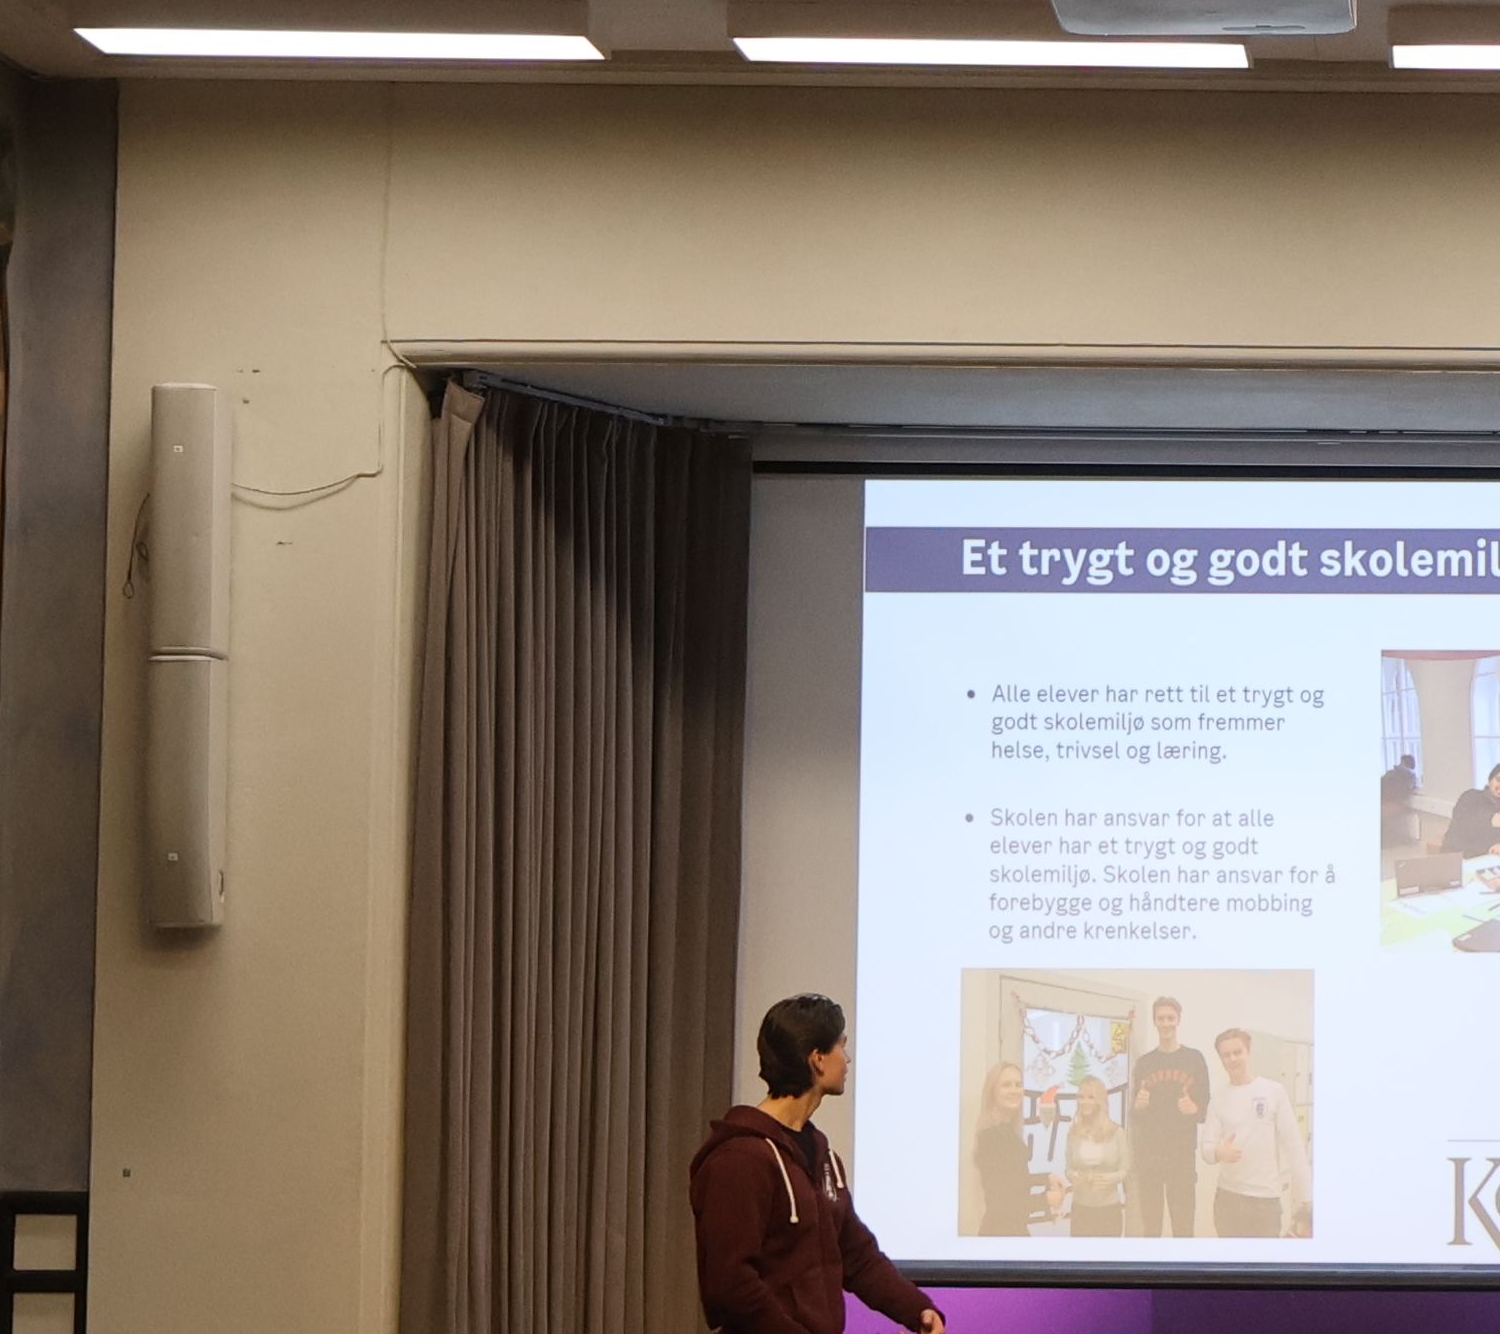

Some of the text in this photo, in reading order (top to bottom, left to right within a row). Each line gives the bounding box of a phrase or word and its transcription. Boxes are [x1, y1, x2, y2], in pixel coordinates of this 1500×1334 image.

[962, 538, 1008, 576] Et
[1018, 540, 1135, 586] trygt
[1146, 548, 1199, 586] og
[1207, 540, 1309, 586] godt
[991, 684, 1325, 709] Alle elever har rett til et trygt og
[991, 711, 1286, 736] godt skolemiljø som fremmer
[991, 740, 1227, 765] helse, trivsel og læring.
[990, 807, 1274, 828] Skolen har ansvar for at alle
[989, 835, 1259, 861] elever har et trygt og godt
[989, 863, 1336, 889] skolemiljø. Skolen har ansvar for å
[988, 890, 1313, 918] forebygge og håndtere mobbing
[988, 921, 1197, 945] og andre krenkelser.
